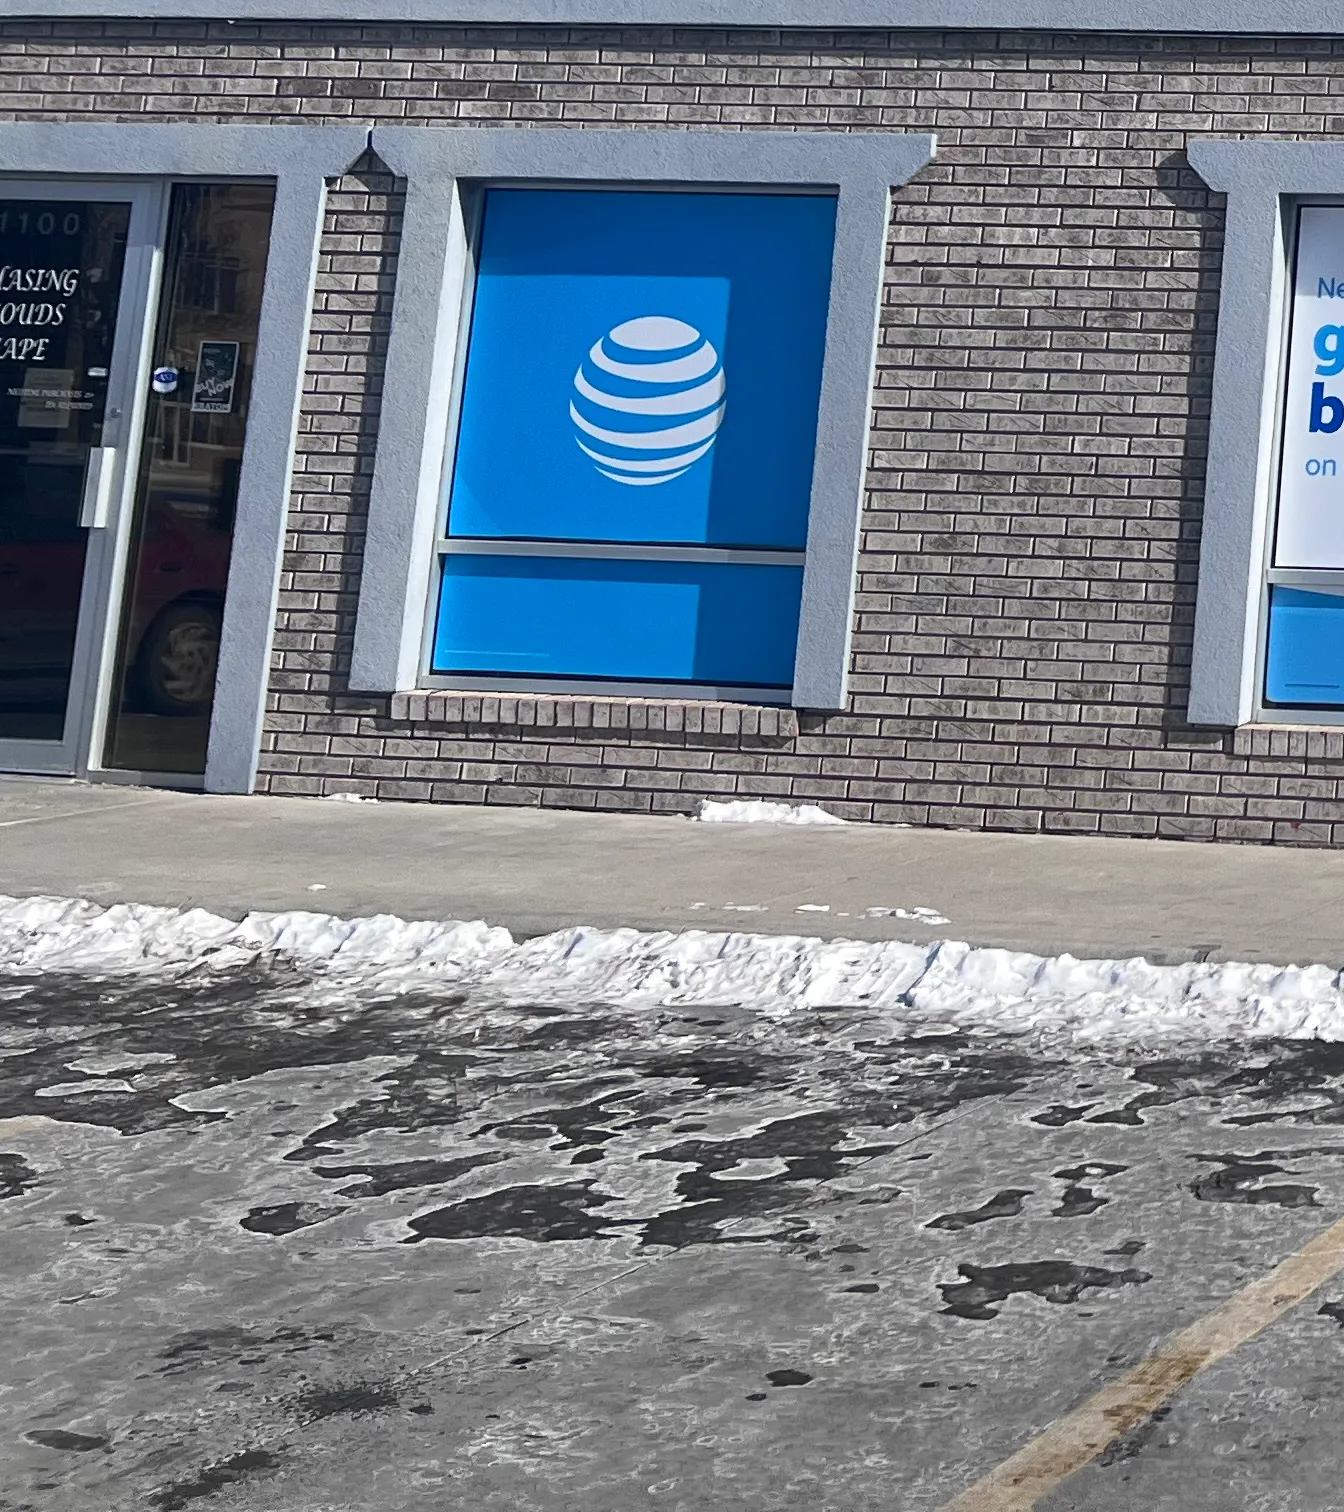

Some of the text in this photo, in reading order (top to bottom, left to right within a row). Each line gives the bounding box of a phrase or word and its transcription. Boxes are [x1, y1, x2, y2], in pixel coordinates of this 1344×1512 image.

[0, 302, 67, 326] OUDS
[0, 337, 50, 361] APE
[1305, 458, 1337, 477] on
